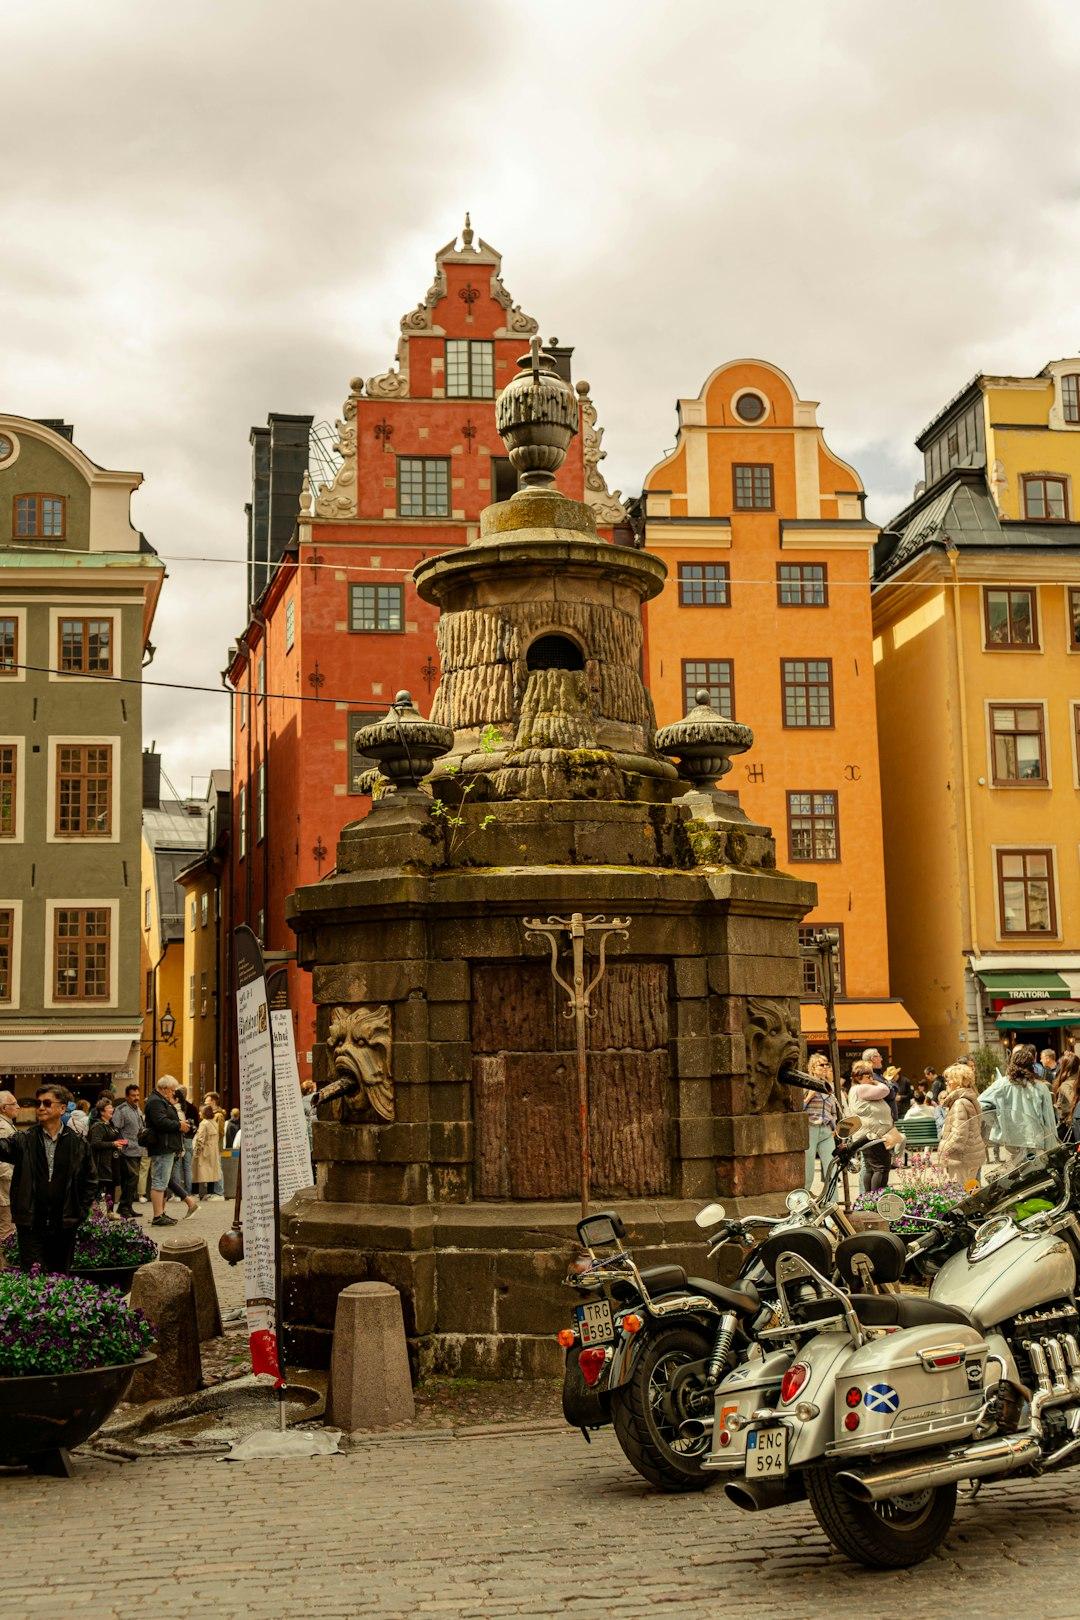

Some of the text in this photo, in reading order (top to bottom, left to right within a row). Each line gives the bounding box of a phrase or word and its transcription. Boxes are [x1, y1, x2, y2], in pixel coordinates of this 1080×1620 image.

[587, 1303, 609, 1320] TRG
[590, 1322, 612, 1339] 595
[758, 1432, 782, 1450] ENC
[757, 1454, 782, 1472] 594
